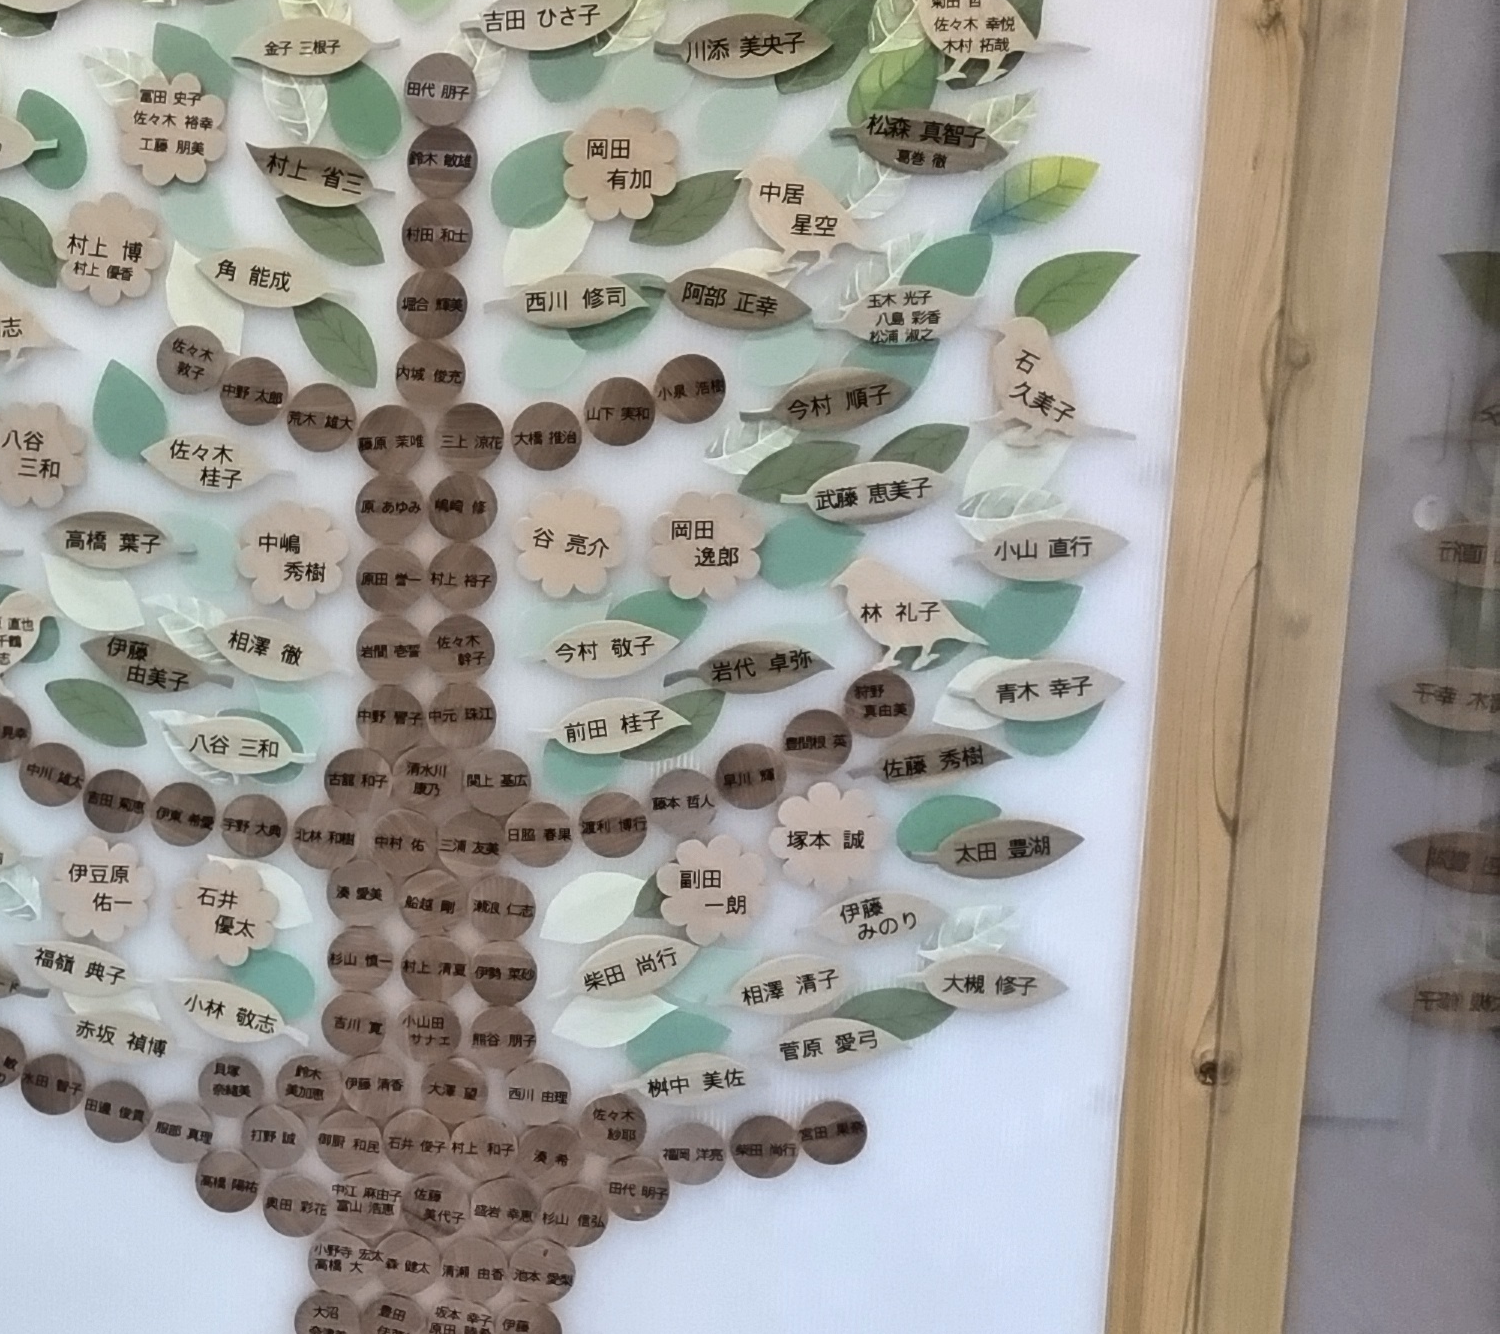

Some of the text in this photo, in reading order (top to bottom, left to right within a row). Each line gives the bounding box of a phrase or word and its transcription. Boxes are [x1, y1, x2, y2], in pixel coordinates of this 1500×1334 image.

[483, 4, 600, 32] 吉田 ひさ子
[934, 17, 1015, 31] 佐々木 幸悦
[265, 40, 340, 56] 金子 三根子
[685, 32, 805, 63] 川添 美央子
[943, 38, 1009, 53] 木村 拓哉
[407, 82, 469, 100] 田代 朋子
[134, 111, 212, 129] 佐々木 裕幸
[867, 115, 985, 148] 松森 真智子
[141, 138, 204, 155] 工藤 朋美
[587, 139, 630, 159] 岡田
[267, 153, 368, 194] 村上 省三
[607, 168, 651, 189] 有加
[760, 182, 804, 205] 中居
[791, 214, 837, 236] 星空
[67, 234, 142, 263] 村上 博
[215, 260, 291, 292] 角 能成
[526, 287, 625, 312] 西川 修司
[682, 282, 778, 316] 阿部 正幸
[1016, 350, 1040, 374] 石
[788, 384, 890, 420] 今村 順子
[1009, 382, 1075, 423] 久美子
[2, 430, 43, 451] 八谷
[170, 440, 233, 465] 佐々木
[18, 458, 60, 478] 三和
[200, 466, 242, 489] 桂子
[815, 477, 932, 511] 武藤 恵美子
[66, 530, 160, 553] 高橋 葉子
[672, 521, 713, 540] 岡田
[259, 534, 300, 554] 中嶋
[533, 528, 609, 557] 谷 亮介
[995, 537, 1092, 561] 小山 直行
[695, 547, 738, 567] 逸郎
[284, 562, 325, 582] 秀樹
[861, 602, 940, 623] 林 礼子
[108, 637, 149, 661] 伊藤
[228, 630, 302, 665] 相澤 徹
[555, 636, 654, 663] 今村 敬子
[712, 650, 812, 682] 岩代 卓弥
[127, 665, 188, 691] 由美子
[996, 676, 1092, 704] 青木 幸子
[564, 710, 663, 743] 前田 桂子
[189, 735, 278, 758] 八谷 三和
[883, 745, 983, 778] 佐藤 秀樹
[787, 830, 864, 850] 塚本 誠
[956, 842, 996, 864] 太田
[69, 864, 129, 883] 伊豆原
[680, 870, 721, 889] 副田
[93, 893, 132, 911] 佑一
[197, 887, 237, 909] 石井
[705, 896, 746, 914] 一朗
[840, 897, 883, 923] 伊藤
[215, 915, 255, 938] 優太
[857, 912, 916, 940] みのり
[85, 962, 125, 985] 典子
[584, 947, 676, 991] 柴田 尚行
[742, 969, 838, 1005] 相澤 清子
[943, 975, 1037, 996] 大槻 修子
[185, 995, 277, 1033] 小林 敬志
[403, 1016, 444, 1030] 小山田
[76, 1021, 116, 1045] 赤坂
[410, 1034, 450, 1046] サナエ
[780, 1030, 877, 1061] 菅原 愛弓
[648, 1069, 745, 1097] 桝中 美佐
[452, 1142, 514, 1157] 村上 和子
